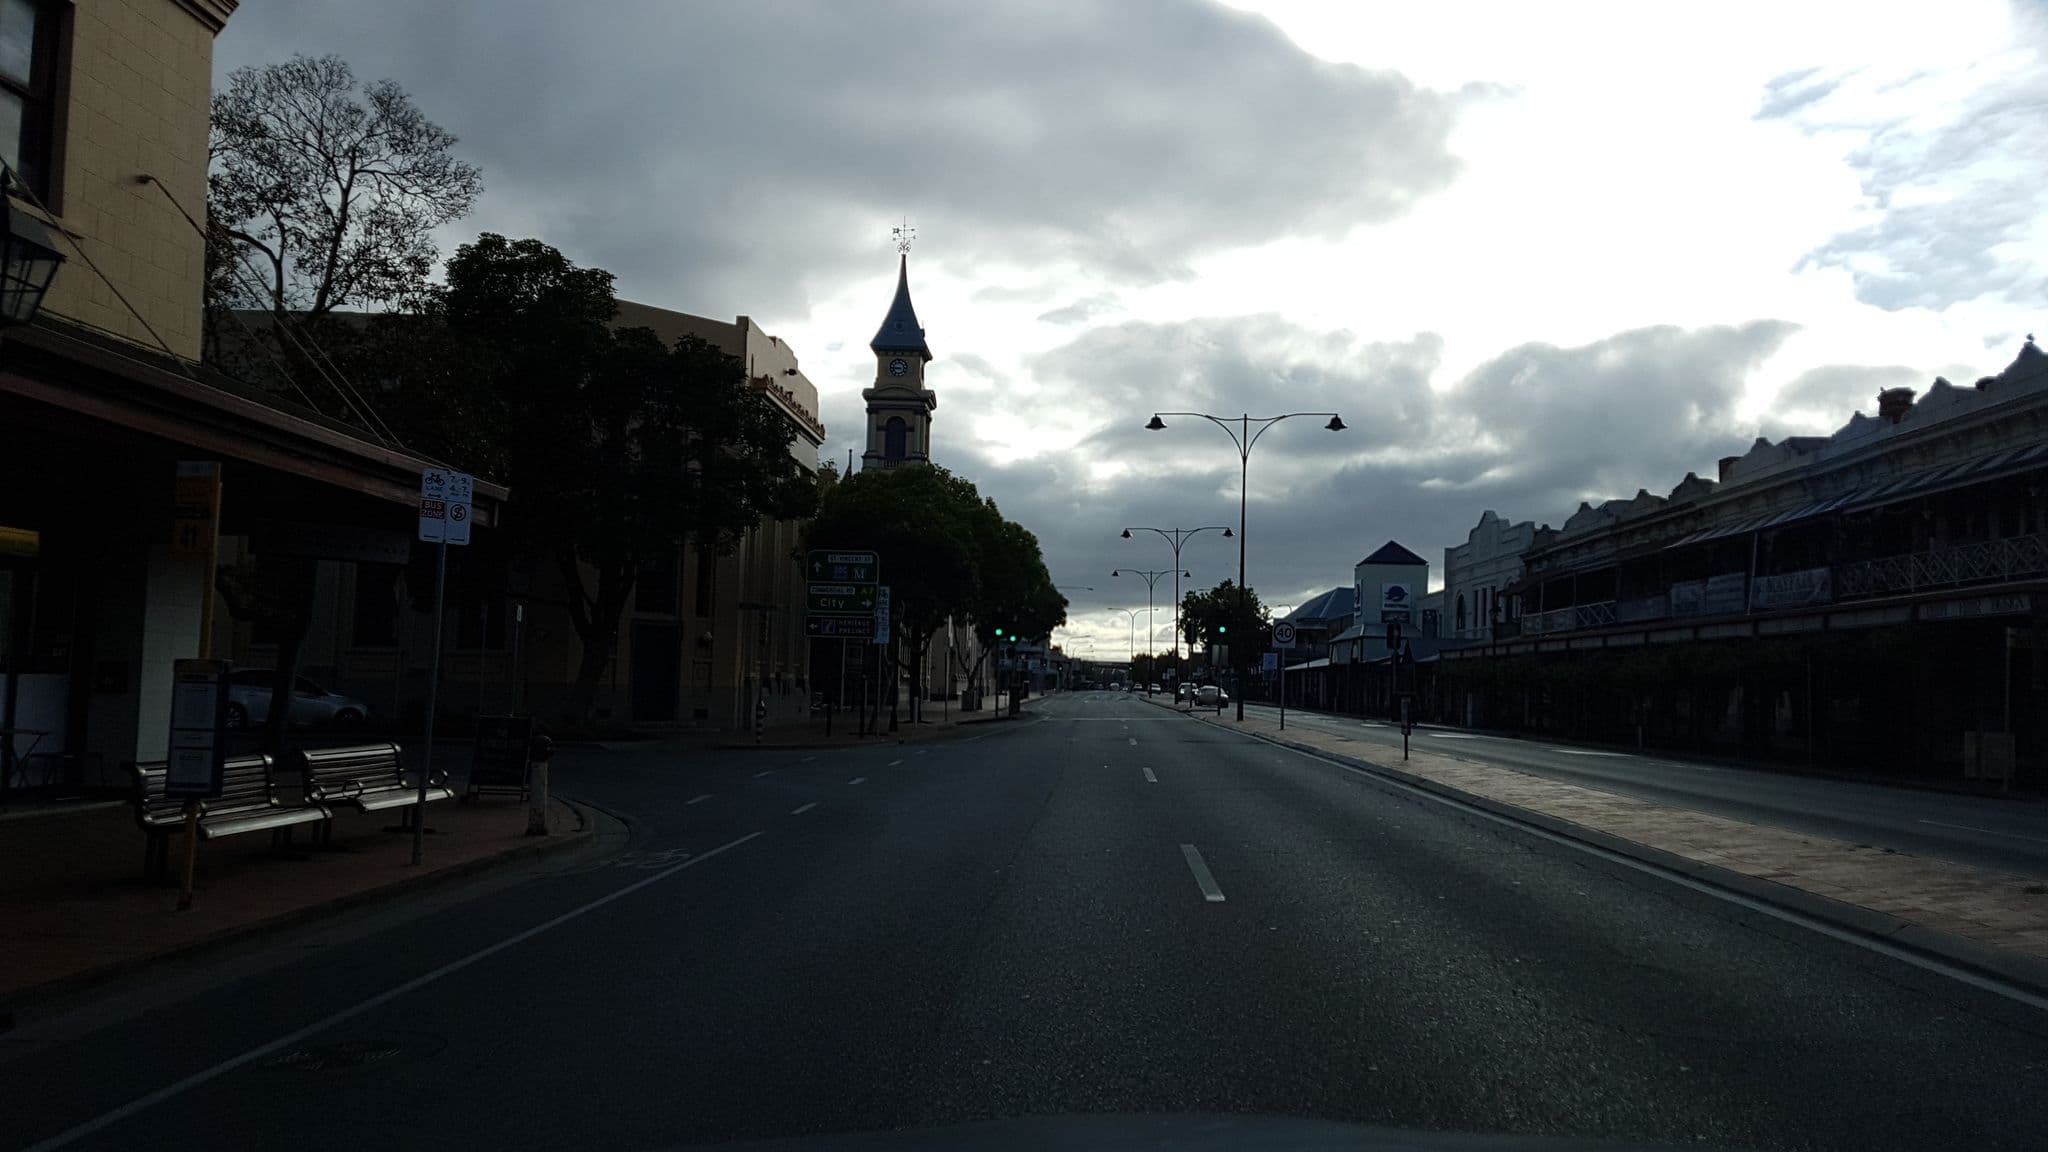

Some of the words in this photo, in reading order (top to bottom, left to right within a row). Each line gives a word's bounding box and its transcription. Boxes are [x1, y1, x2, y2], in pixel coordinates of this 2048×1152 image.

[424, 501, 442, 510] BUS
[422, 510, 444, 519] ZONE
[1277, 627, 1292, 638] 40
